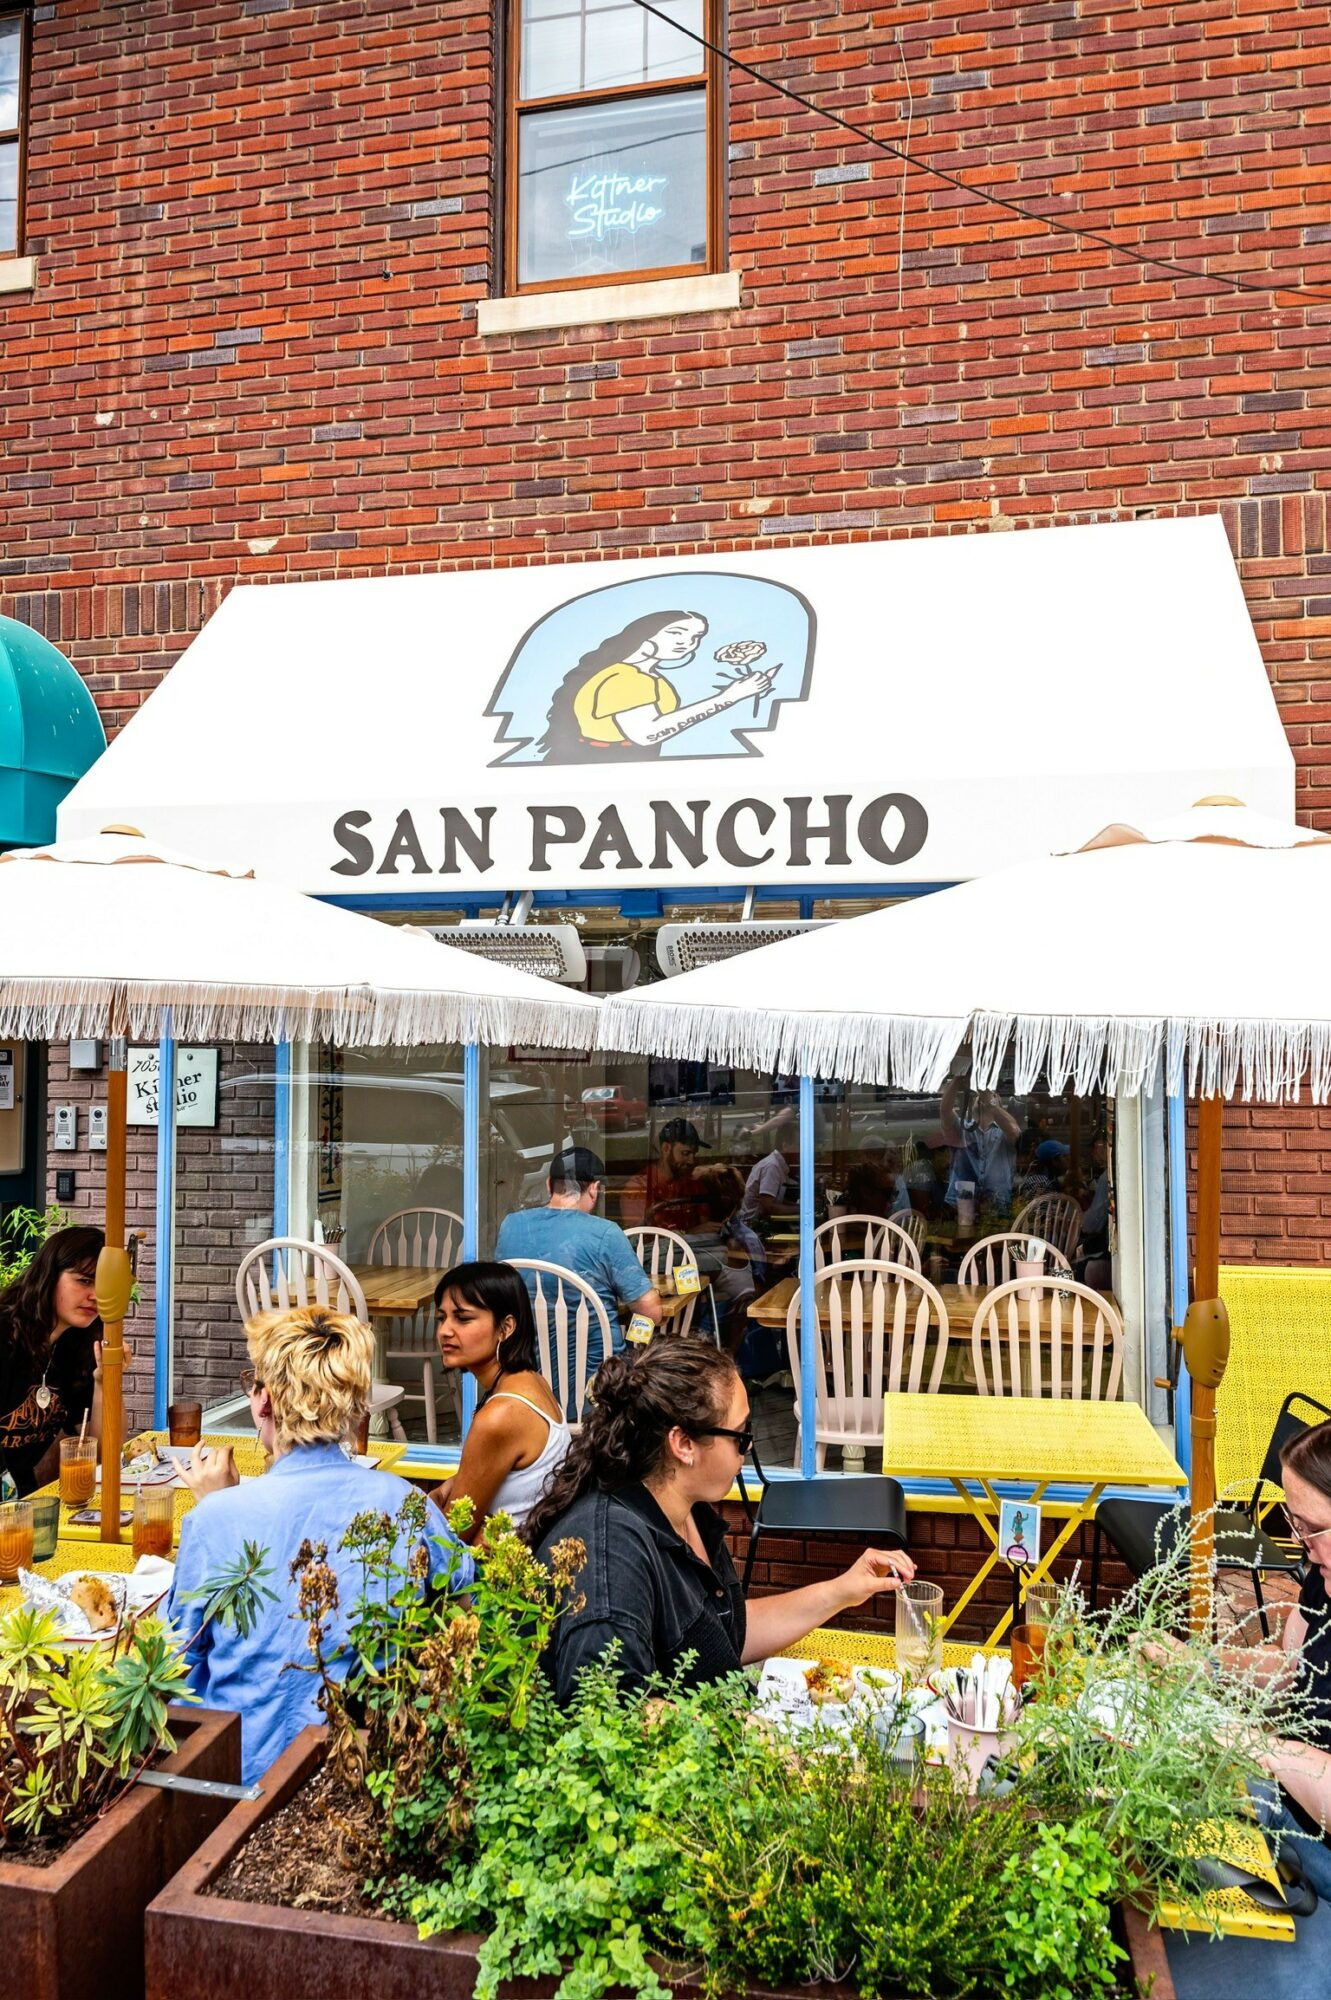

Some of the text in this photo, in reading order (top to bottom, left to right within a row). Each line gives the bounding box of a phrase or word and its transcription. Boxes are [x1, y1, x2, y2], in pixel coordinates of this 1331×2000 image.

[568, 201, 662, 237] Studio
[330, 793, 929, 877] SAN PANCHO
[132, 1060, 160, 1073] 705
[135, 1072, 202, 1098] Kiner
